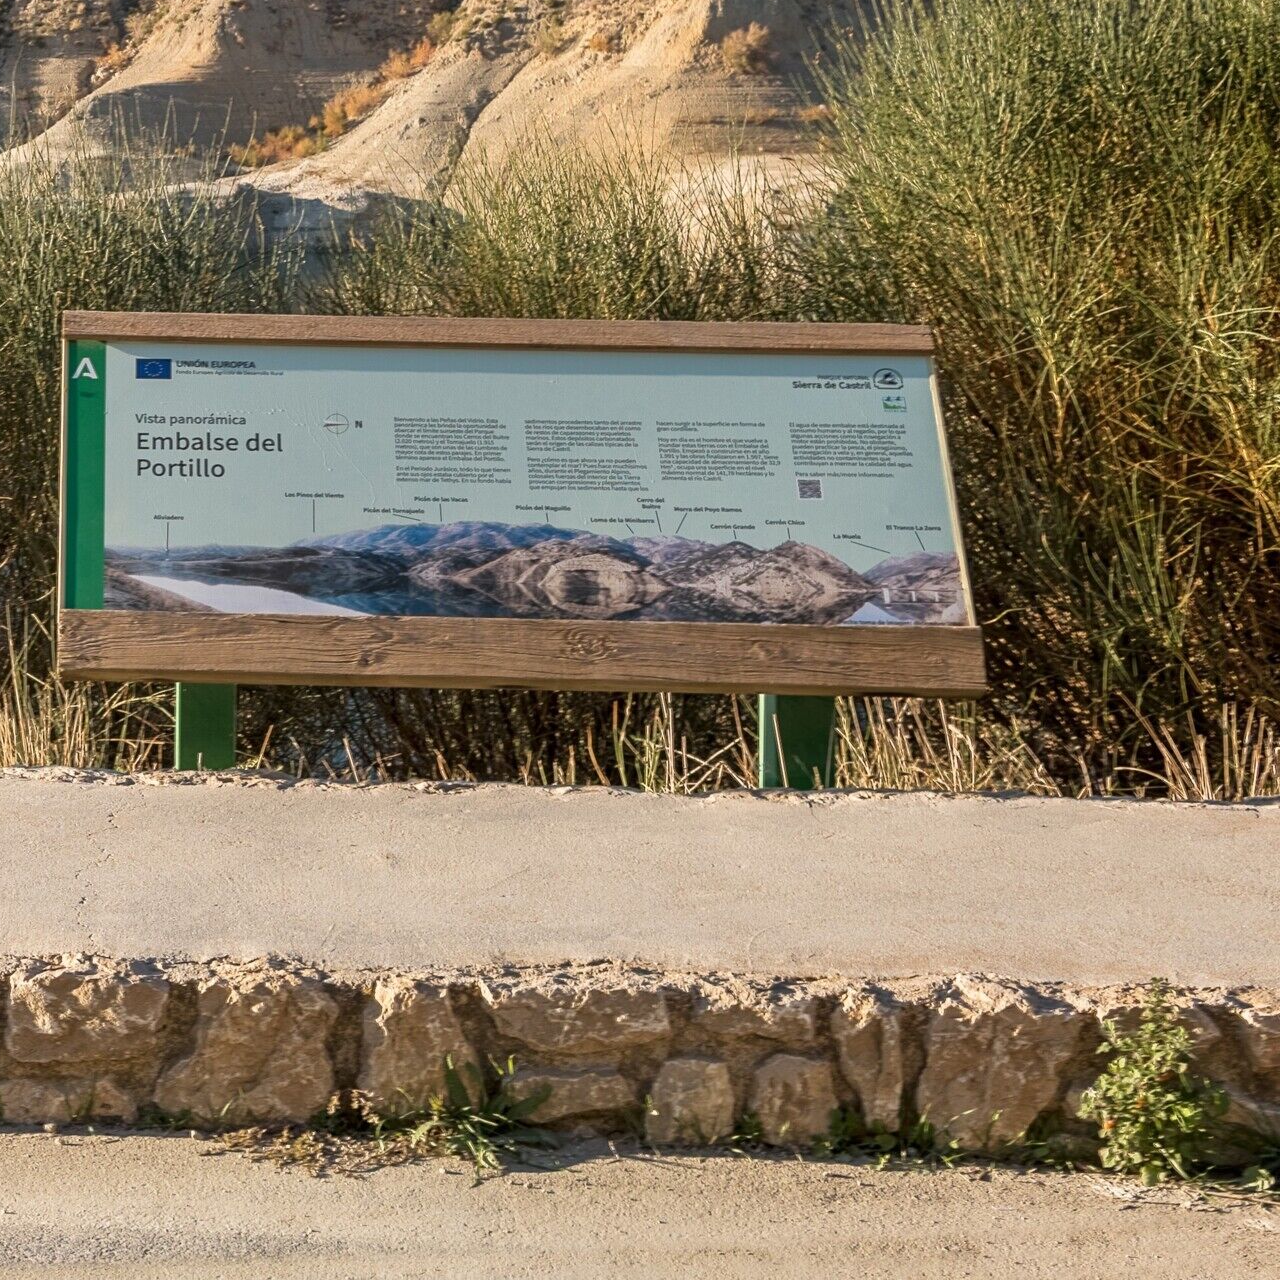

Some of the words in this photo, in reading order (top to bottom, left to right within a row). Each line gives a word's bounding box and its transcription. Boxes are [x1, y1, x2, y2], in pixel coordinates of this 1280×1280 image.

[176, 359, 209, 368] UNIÓN
[210, 360, 256, 368] EUROPEA
[792, 380, 822, 389] Sierra
[824, 381, 836, 389] de
[838, 381, 872, 390] Castril
[136, 414, 166, 424] Vista
[170, 414, 246, 426] panorámica
[354, 420, 363, 428] N
[137, 432, 239, 451] Embalse
[246, 432, 284, 452] del
[137, 458, 226, 478] Portillo
